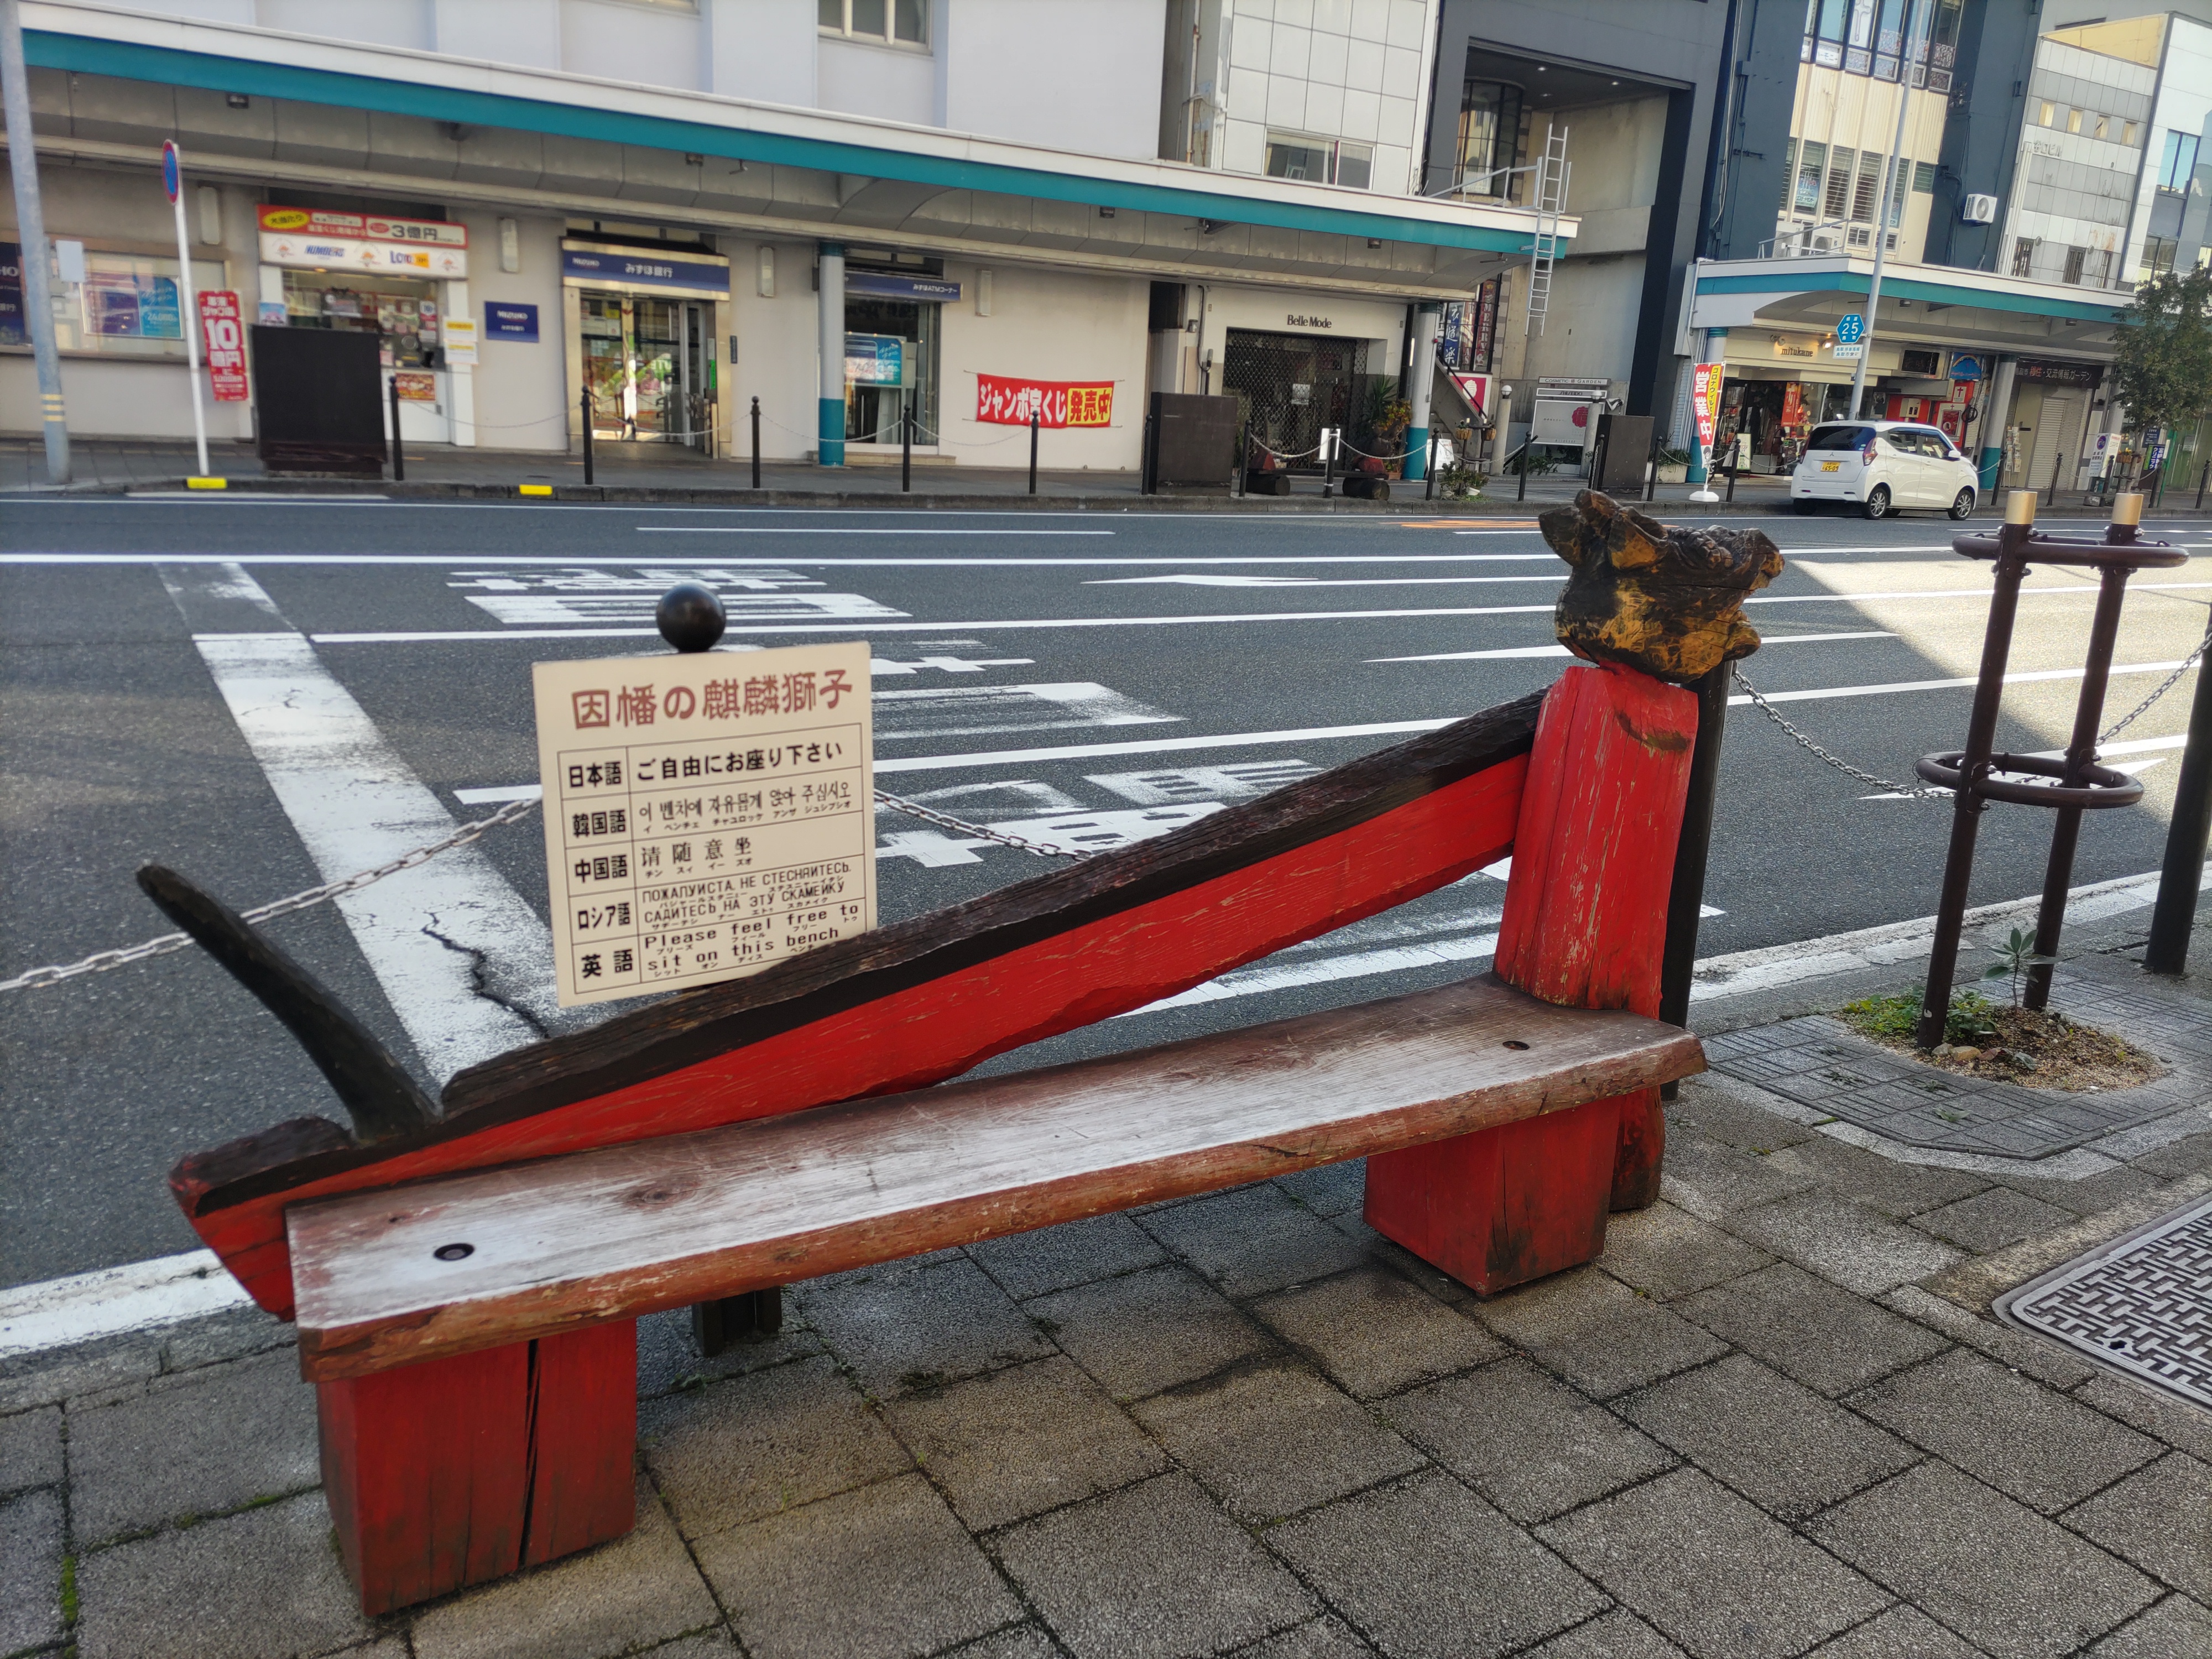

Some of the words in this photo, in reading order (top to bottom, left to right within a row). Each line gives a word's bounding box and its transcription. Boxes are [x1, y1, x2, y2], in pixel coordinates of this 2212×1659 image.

[625, 263, 673, 278] みずほ銀行
[913, 284, 957, 294] みずほATMコーナー
[205, 319, 238, 349] 10
[1287, 314, 1309, 326] Belle
[1310, 316, 1332, 328] Mode
[1841, 322, 1859, 335] 25
[1781, 346, 1813, 357] mitukane
[980, 382, 1067, 424] ジャンボ宝くじ
[1070, 388, 1110, 422] 発売中
[1694, 371, 1712, 440] 営業中
[572, 669, 853, 729] 因幡の麒麟獅子
[569, 761, 622, 787] 日本語
[638, 742, 842, 780] ご自由にお座り下さい
[639, 802, 651, 822] 이
[660, 797, 702, 821] 벤치에
[802, 780, 852, 802] 주십시오
[572, 810, 626, 838] 韓国語
[575, 854, 627, 884] 中国語
[740, 876, 756, 889] НЕ
[578, 902, 630, 930] ロシア語
[645, 902, 716, 924] САДИТЕСЬ
[724, 899, 740, 912] НА
[750, 893, 774, 907] ЭТУ
[645, 930, 717, 950] Please
[731, 917, 771, 936] feel
[787, 910, 827, 925] free
[840, 904, 858, 916] to
[581, 949, 633, 979] 英語
[648, 954, 681, 971] sit
[696, 951, 718, 963] on
[732, 941, 774, 956] this
[787, 927, 839, 947] bench
